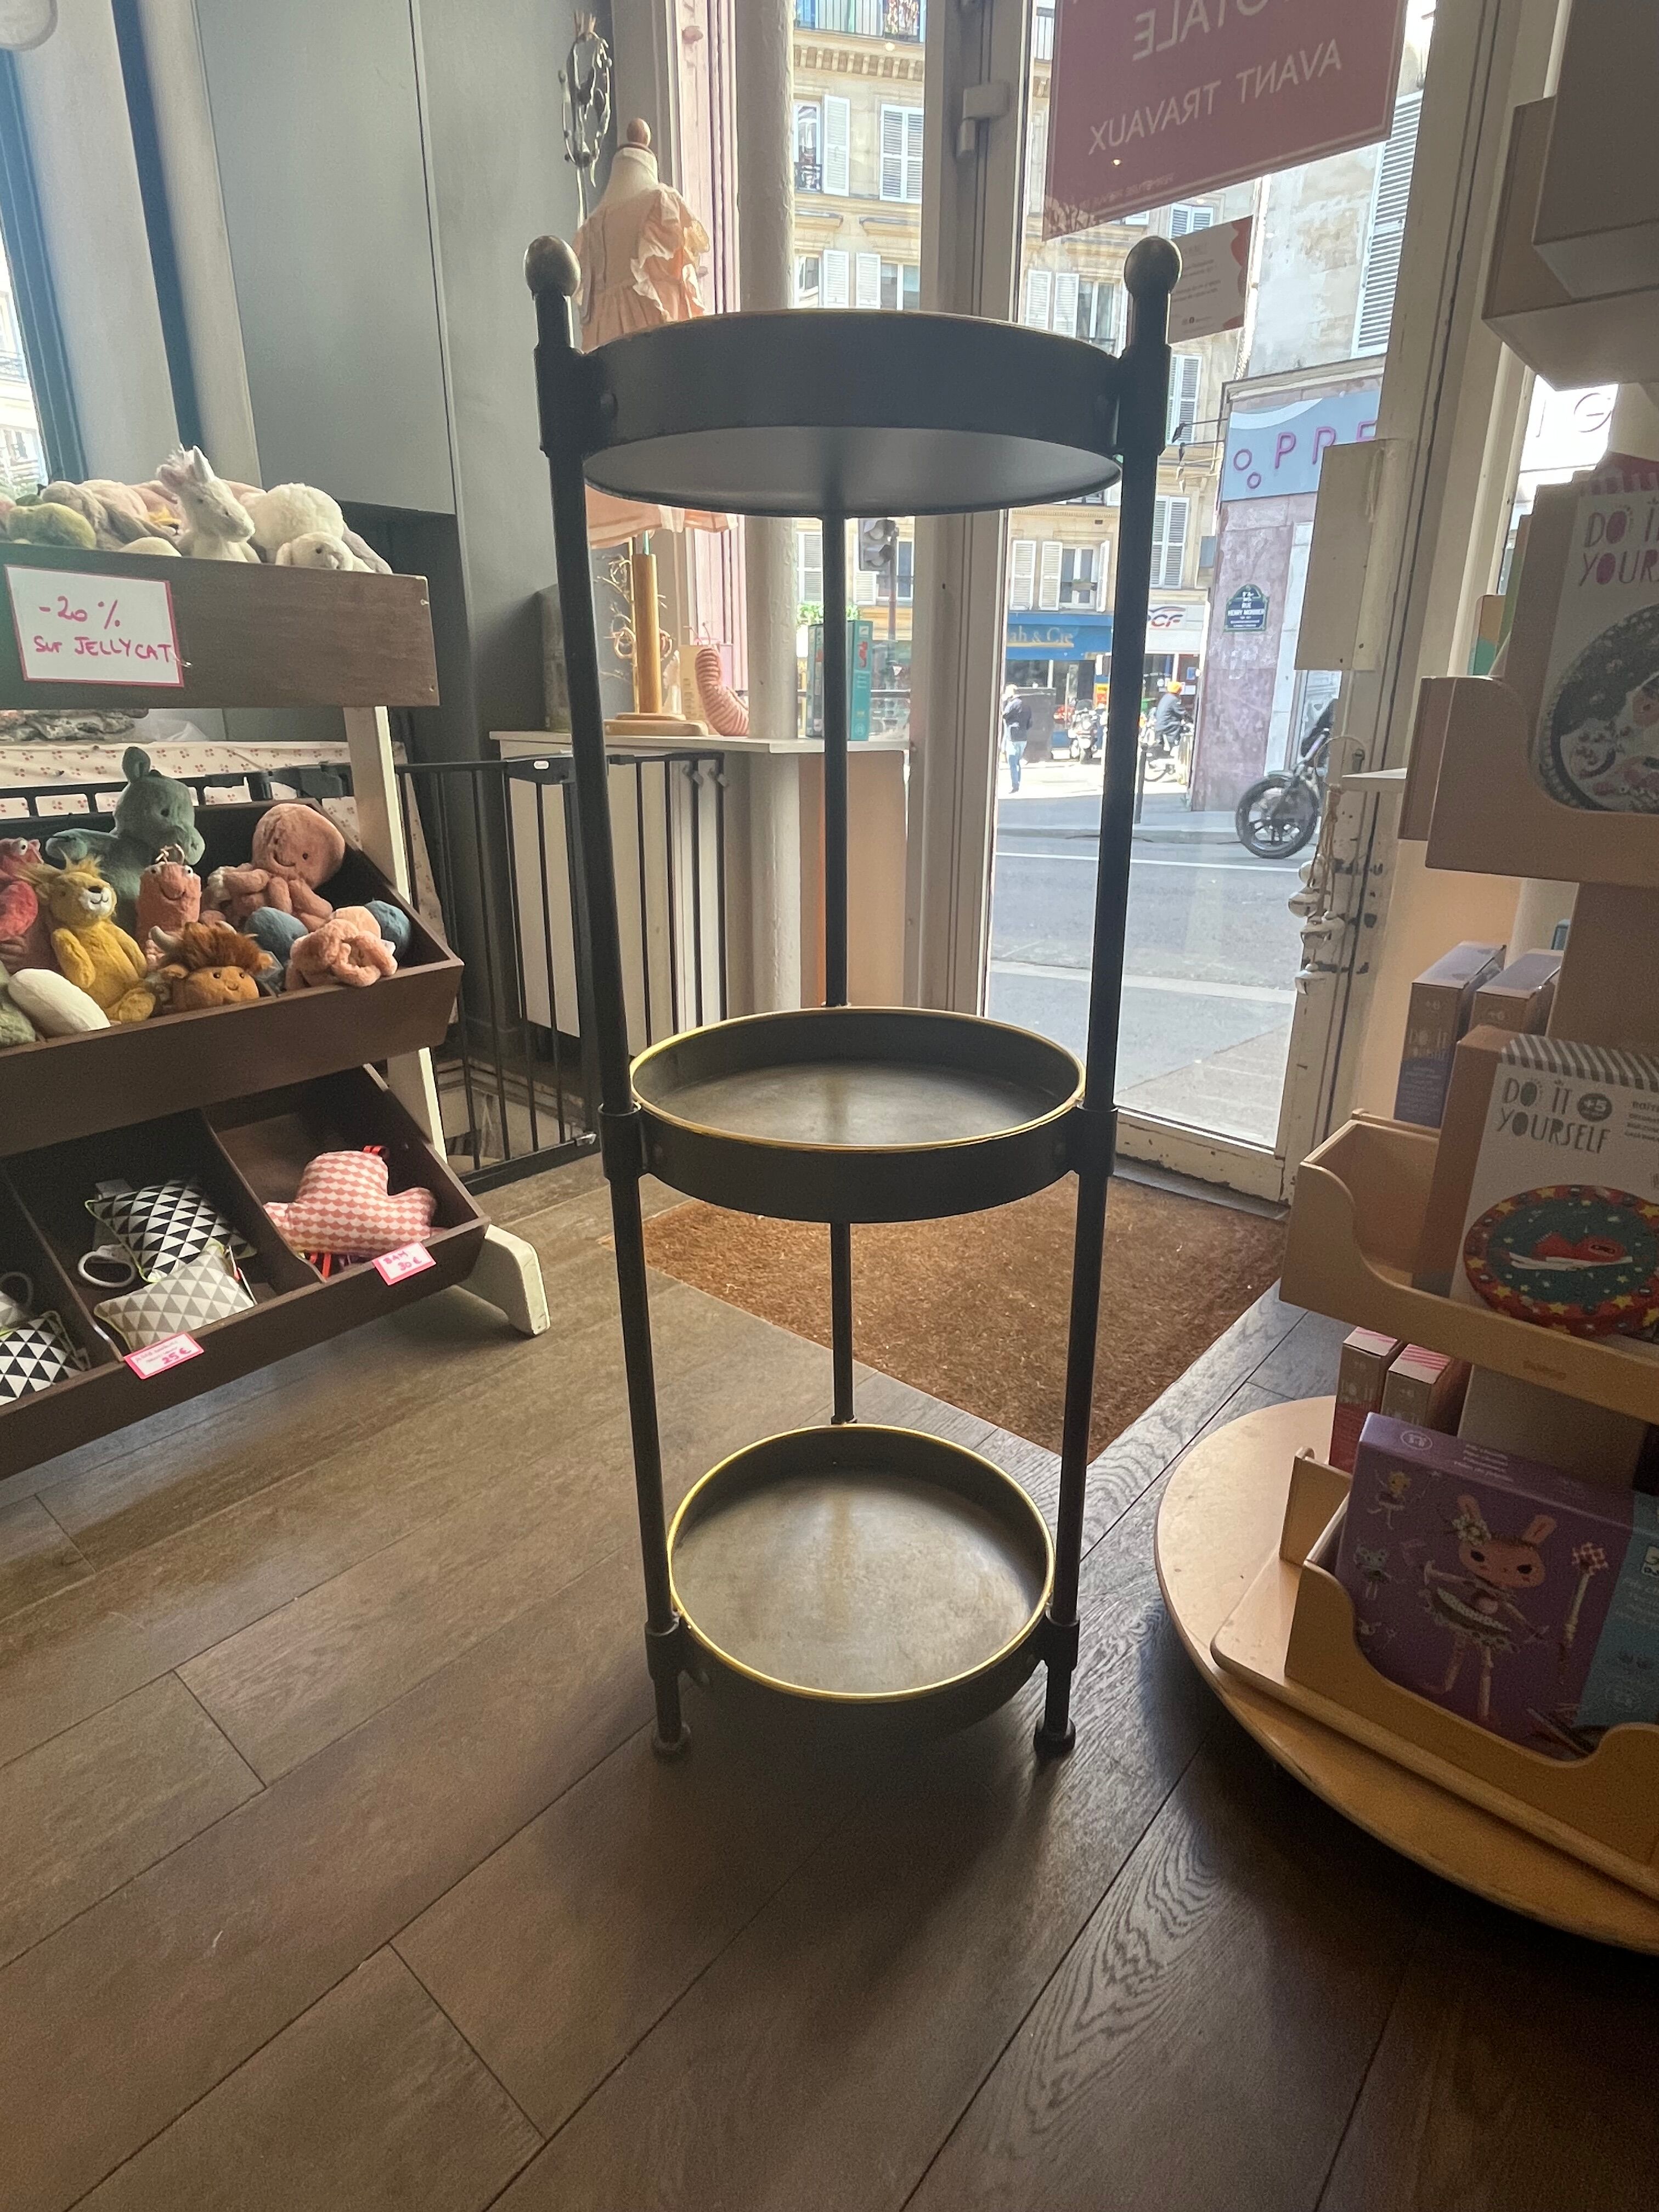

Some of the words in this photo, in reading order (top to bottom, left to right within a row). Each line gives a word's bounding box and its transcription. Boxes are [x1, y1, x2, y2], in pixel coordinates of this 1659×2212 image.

[1584, 511, 1627, 548] DO
[1644, 504, 1659, 542] I
[1579, 549, 1659, 586] YOUR
[1503, 1077, 1537, 1107] DO
[1552, 1083, 1572, 1115] IT
[1497, 1108, 1611, 1154] YOURSELF
[162, 1352, 179, 1364] 25
